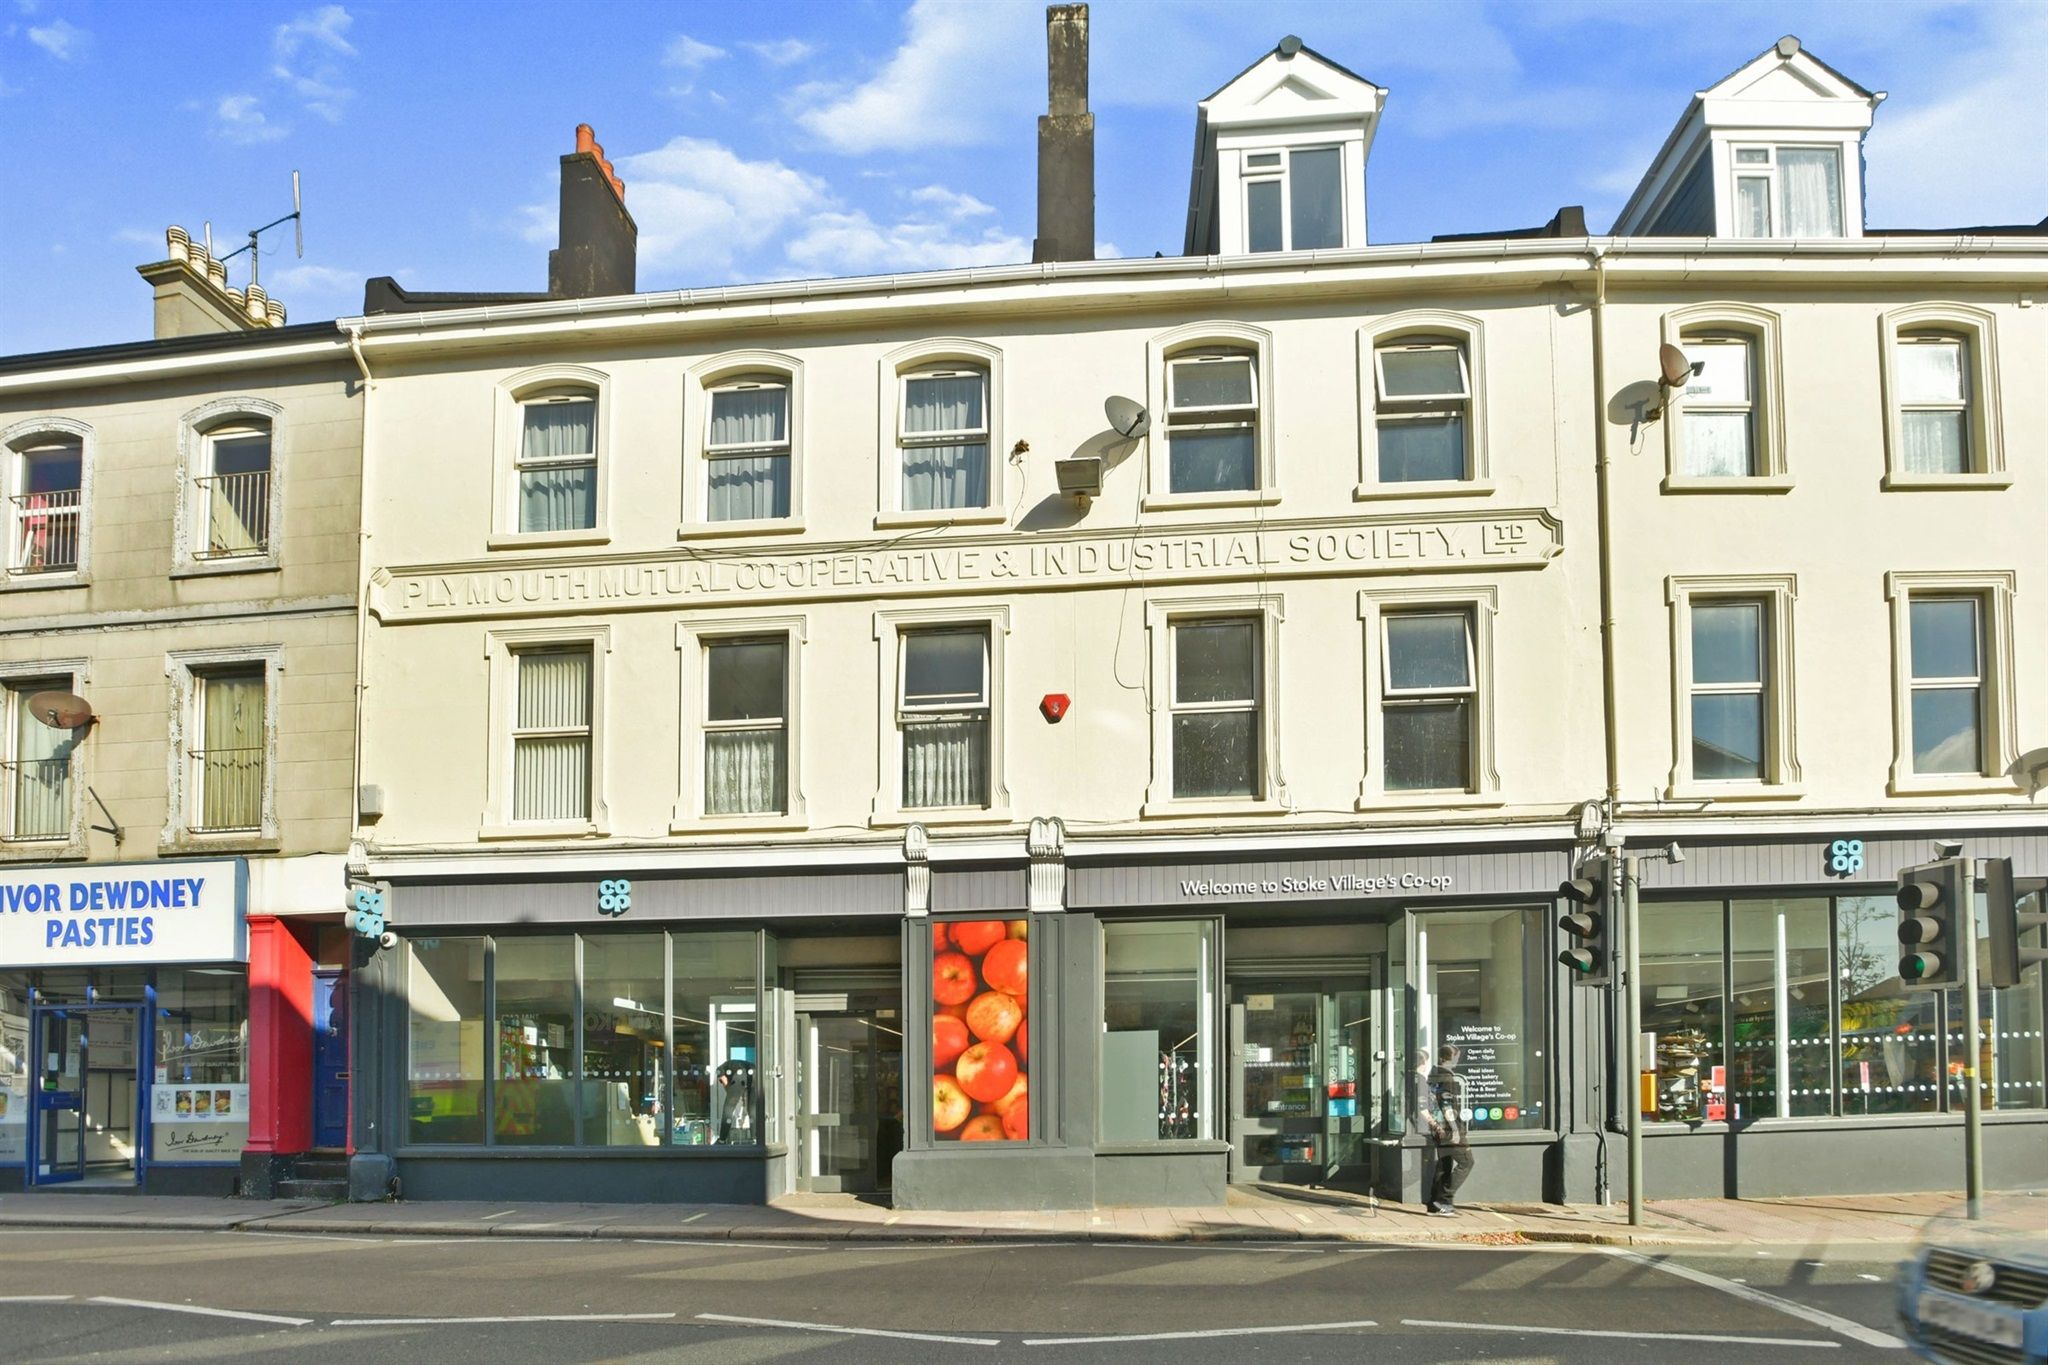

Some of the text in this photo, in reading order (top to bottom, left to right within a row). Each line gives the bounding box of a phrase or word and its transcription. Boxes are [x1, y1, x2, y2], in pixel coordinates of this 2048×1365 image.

[402, 567, 592, 609] PLYMOUTH
[598, 562, 731, 598] MUTUAL
[735, 551, 981, 590] CO-OPERATIVE
[990, 550, 1020, 578] &
[1030, 536, 1281, 577] INDUSTRIAL
[69, 877, 206, 911] DEWDNEY
[1180, 871, 1453, 896] Welcome to Stoke Village's Co-op
[46, 916, 155, 948] PASTIES
[1446, 1032, 1517, 1042] Stoke Village's Co-op
[1461, 1025, 1493, 1033] Welcome
